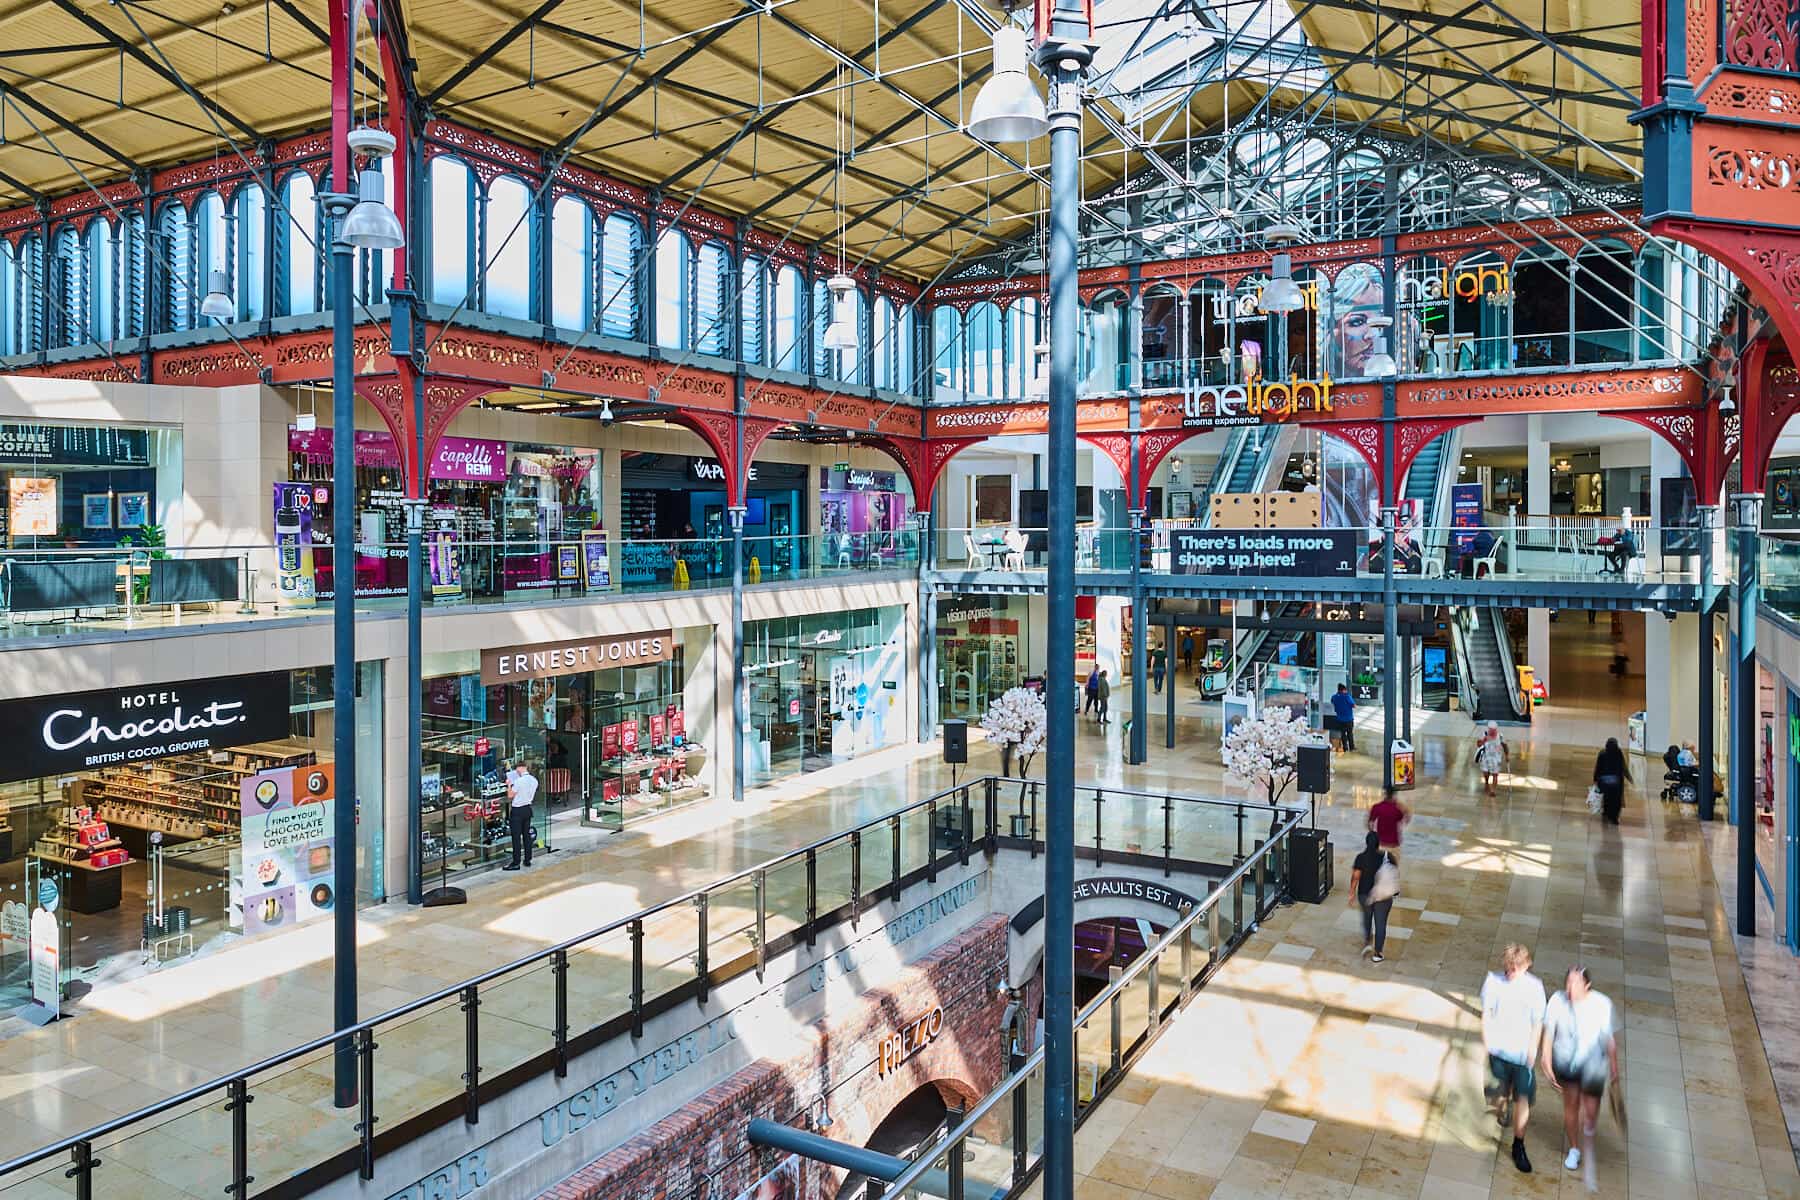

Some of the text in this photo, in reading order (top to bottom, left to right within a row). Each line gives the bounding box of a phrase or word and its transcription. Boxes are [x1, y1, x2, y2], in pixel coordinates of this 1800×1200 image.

[1183, 415, 1260, 427] cinema experience
[440, 444, 493, 471] capelli
[465, 463, 493, 476] REMI
[1178, 535, 1334, 550] There's loads more
[1178, 552, 1297, 569] shops up here!
[946, 606, 995, 624] vision express
[499, 637, 663, 676] ERNEST JONES
[121, 691, 180, 709] HOTEL
[85, 738, 210, 766] BRITISH COCOA GROWER
[264, 817, 324, 839] CHOCOLATE
[272, 815, 290, 825] FIND
[263, 828, 325, 849] LOVE MATCH
[1073, 887, 1089, 899] HE
[1090, 881, 1144, 898] VAULTS
[1146, 885, 1173, 906] EST.
